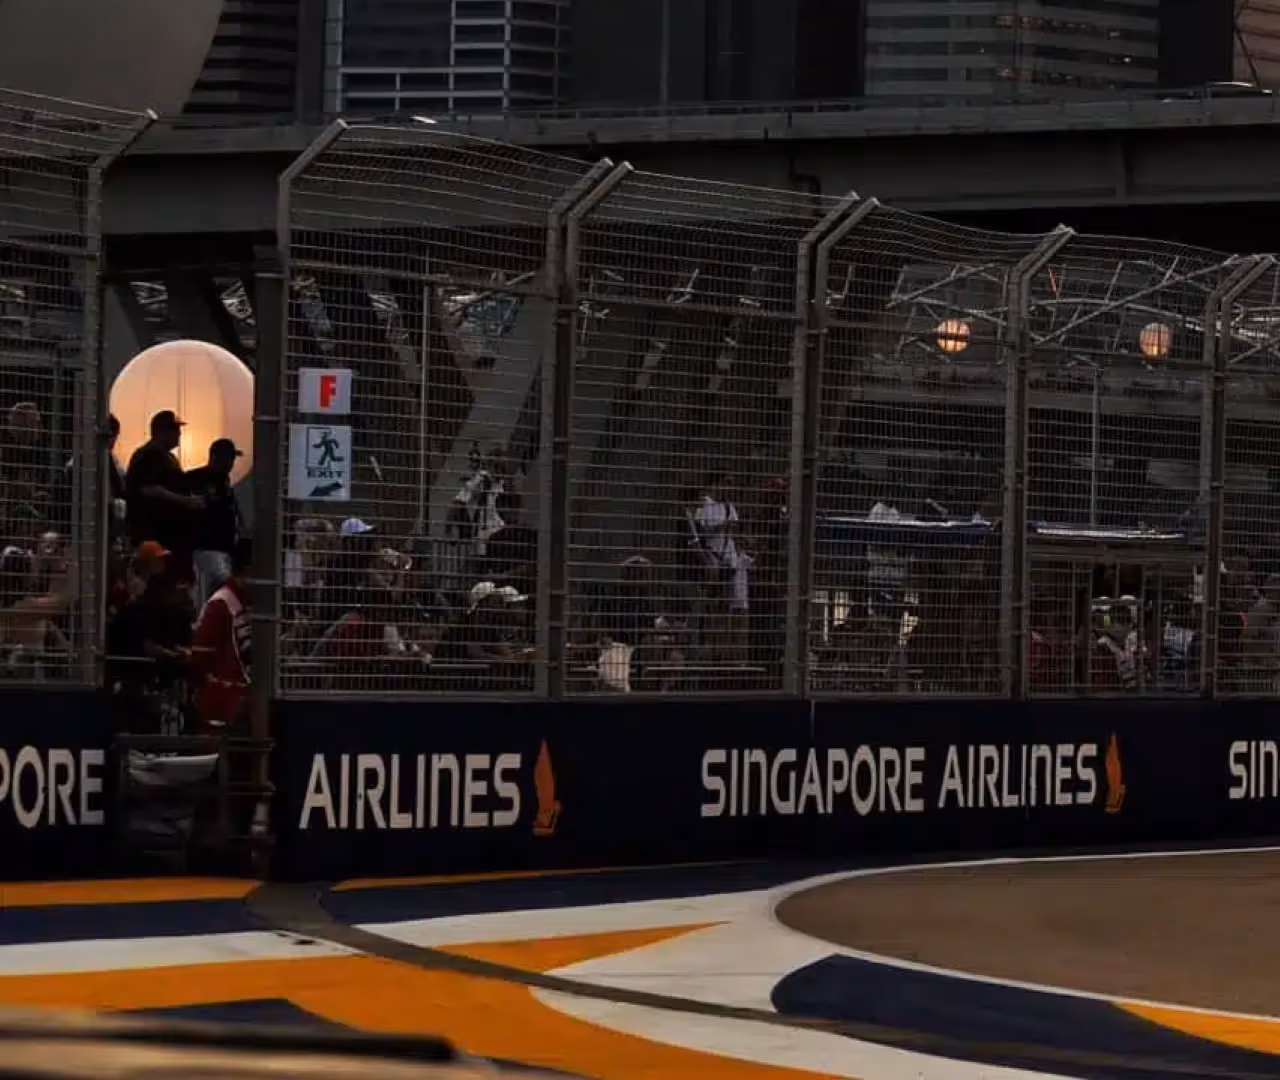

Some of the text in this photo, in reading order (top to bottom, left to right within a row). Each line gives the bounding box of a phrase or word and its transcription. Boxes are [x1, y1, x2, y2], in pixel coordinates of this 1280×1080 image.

[320, 375, 337, 408] F
[298, 753, 522, 829] AIRLINES
[700, 743, 1097, 817] SINGAPORE AIRLINES
